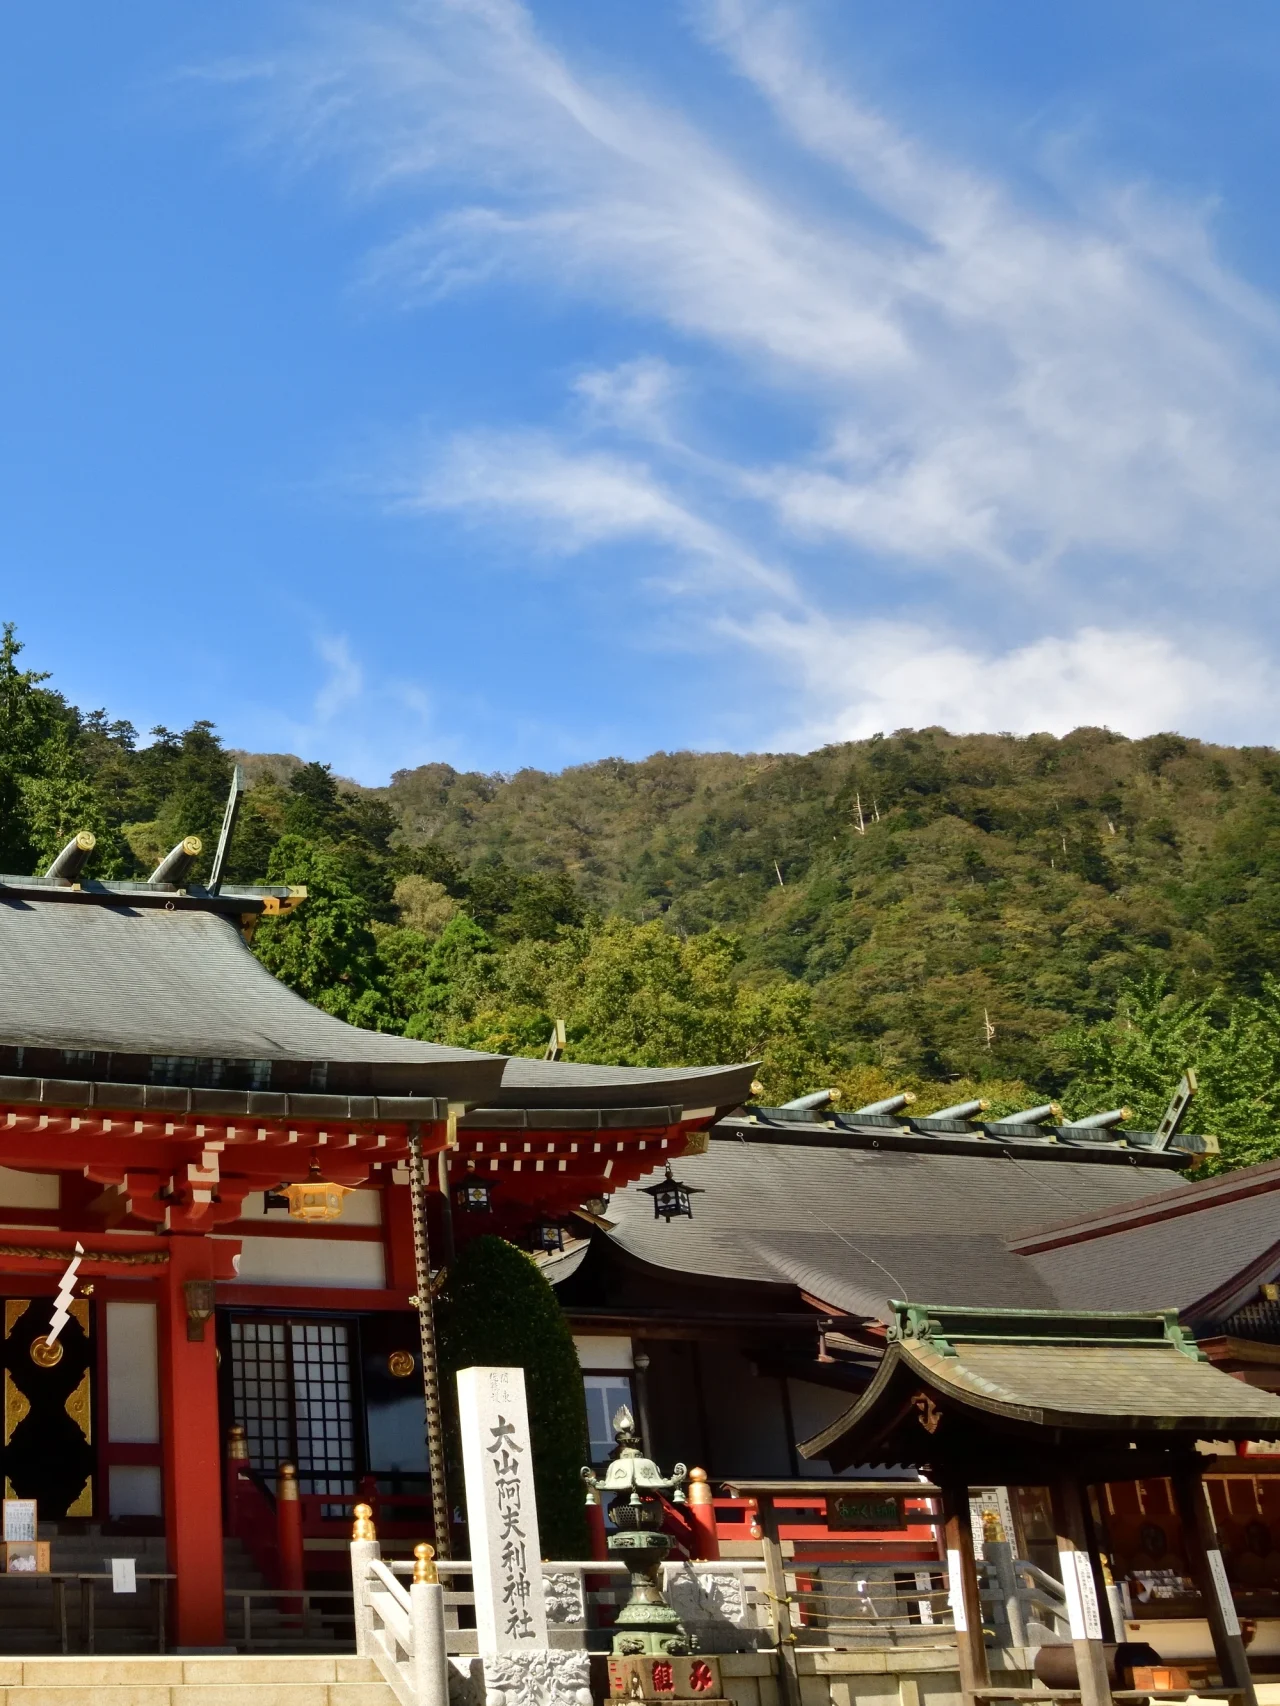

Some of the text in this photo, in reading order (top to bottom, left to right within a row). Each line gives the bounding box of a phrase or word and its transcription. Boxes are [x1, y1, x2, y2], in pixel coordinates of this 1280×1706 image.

[486, 1415, 536, 1639] 大山阿夫利神社
